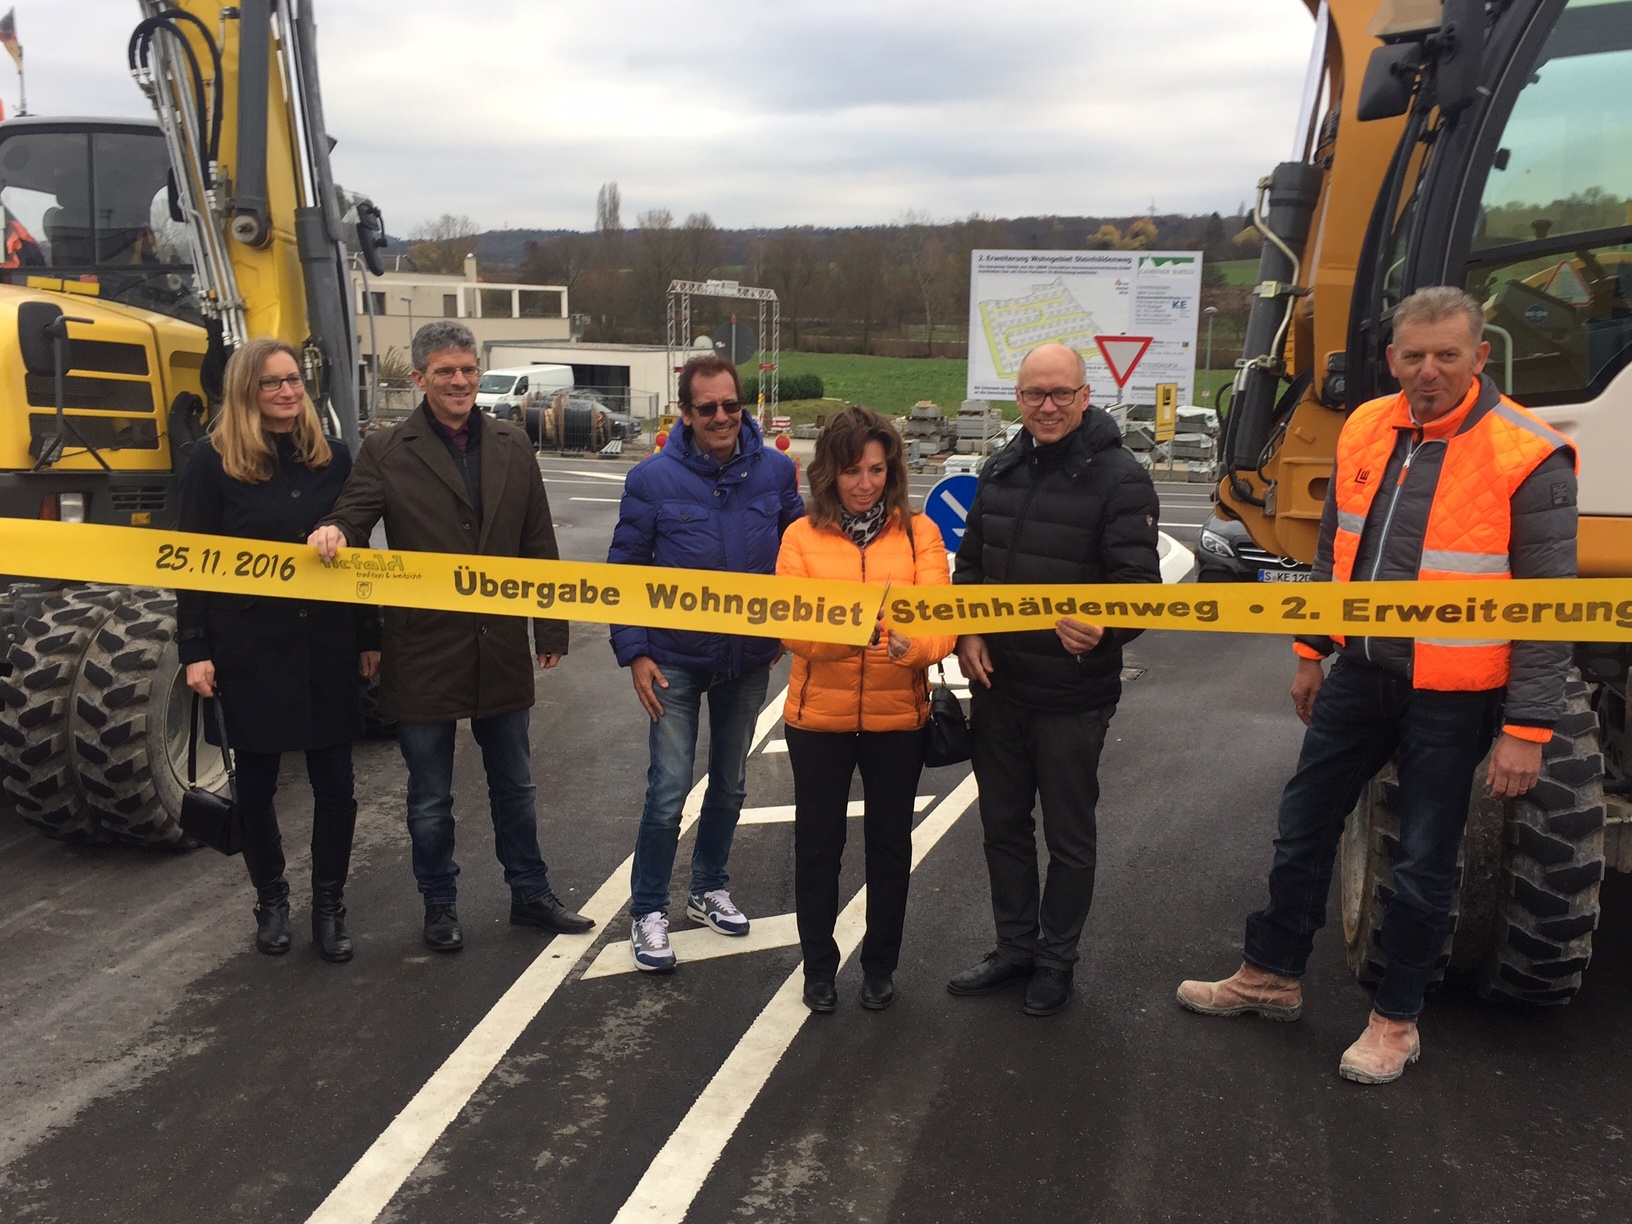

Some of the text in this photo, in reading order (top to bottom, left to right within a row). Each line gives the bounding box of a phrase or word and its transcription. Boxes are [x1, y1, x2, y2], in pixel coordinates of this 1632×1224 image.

[1172, 300, 1187, 309] KE
[356, 571, 384, 580] tradition
[1277, 572, 1290, 582] KE
[454, 566, 1632, 629] Übergabe Wohngebiet Steinhäldenweg 2. Erweiterung
